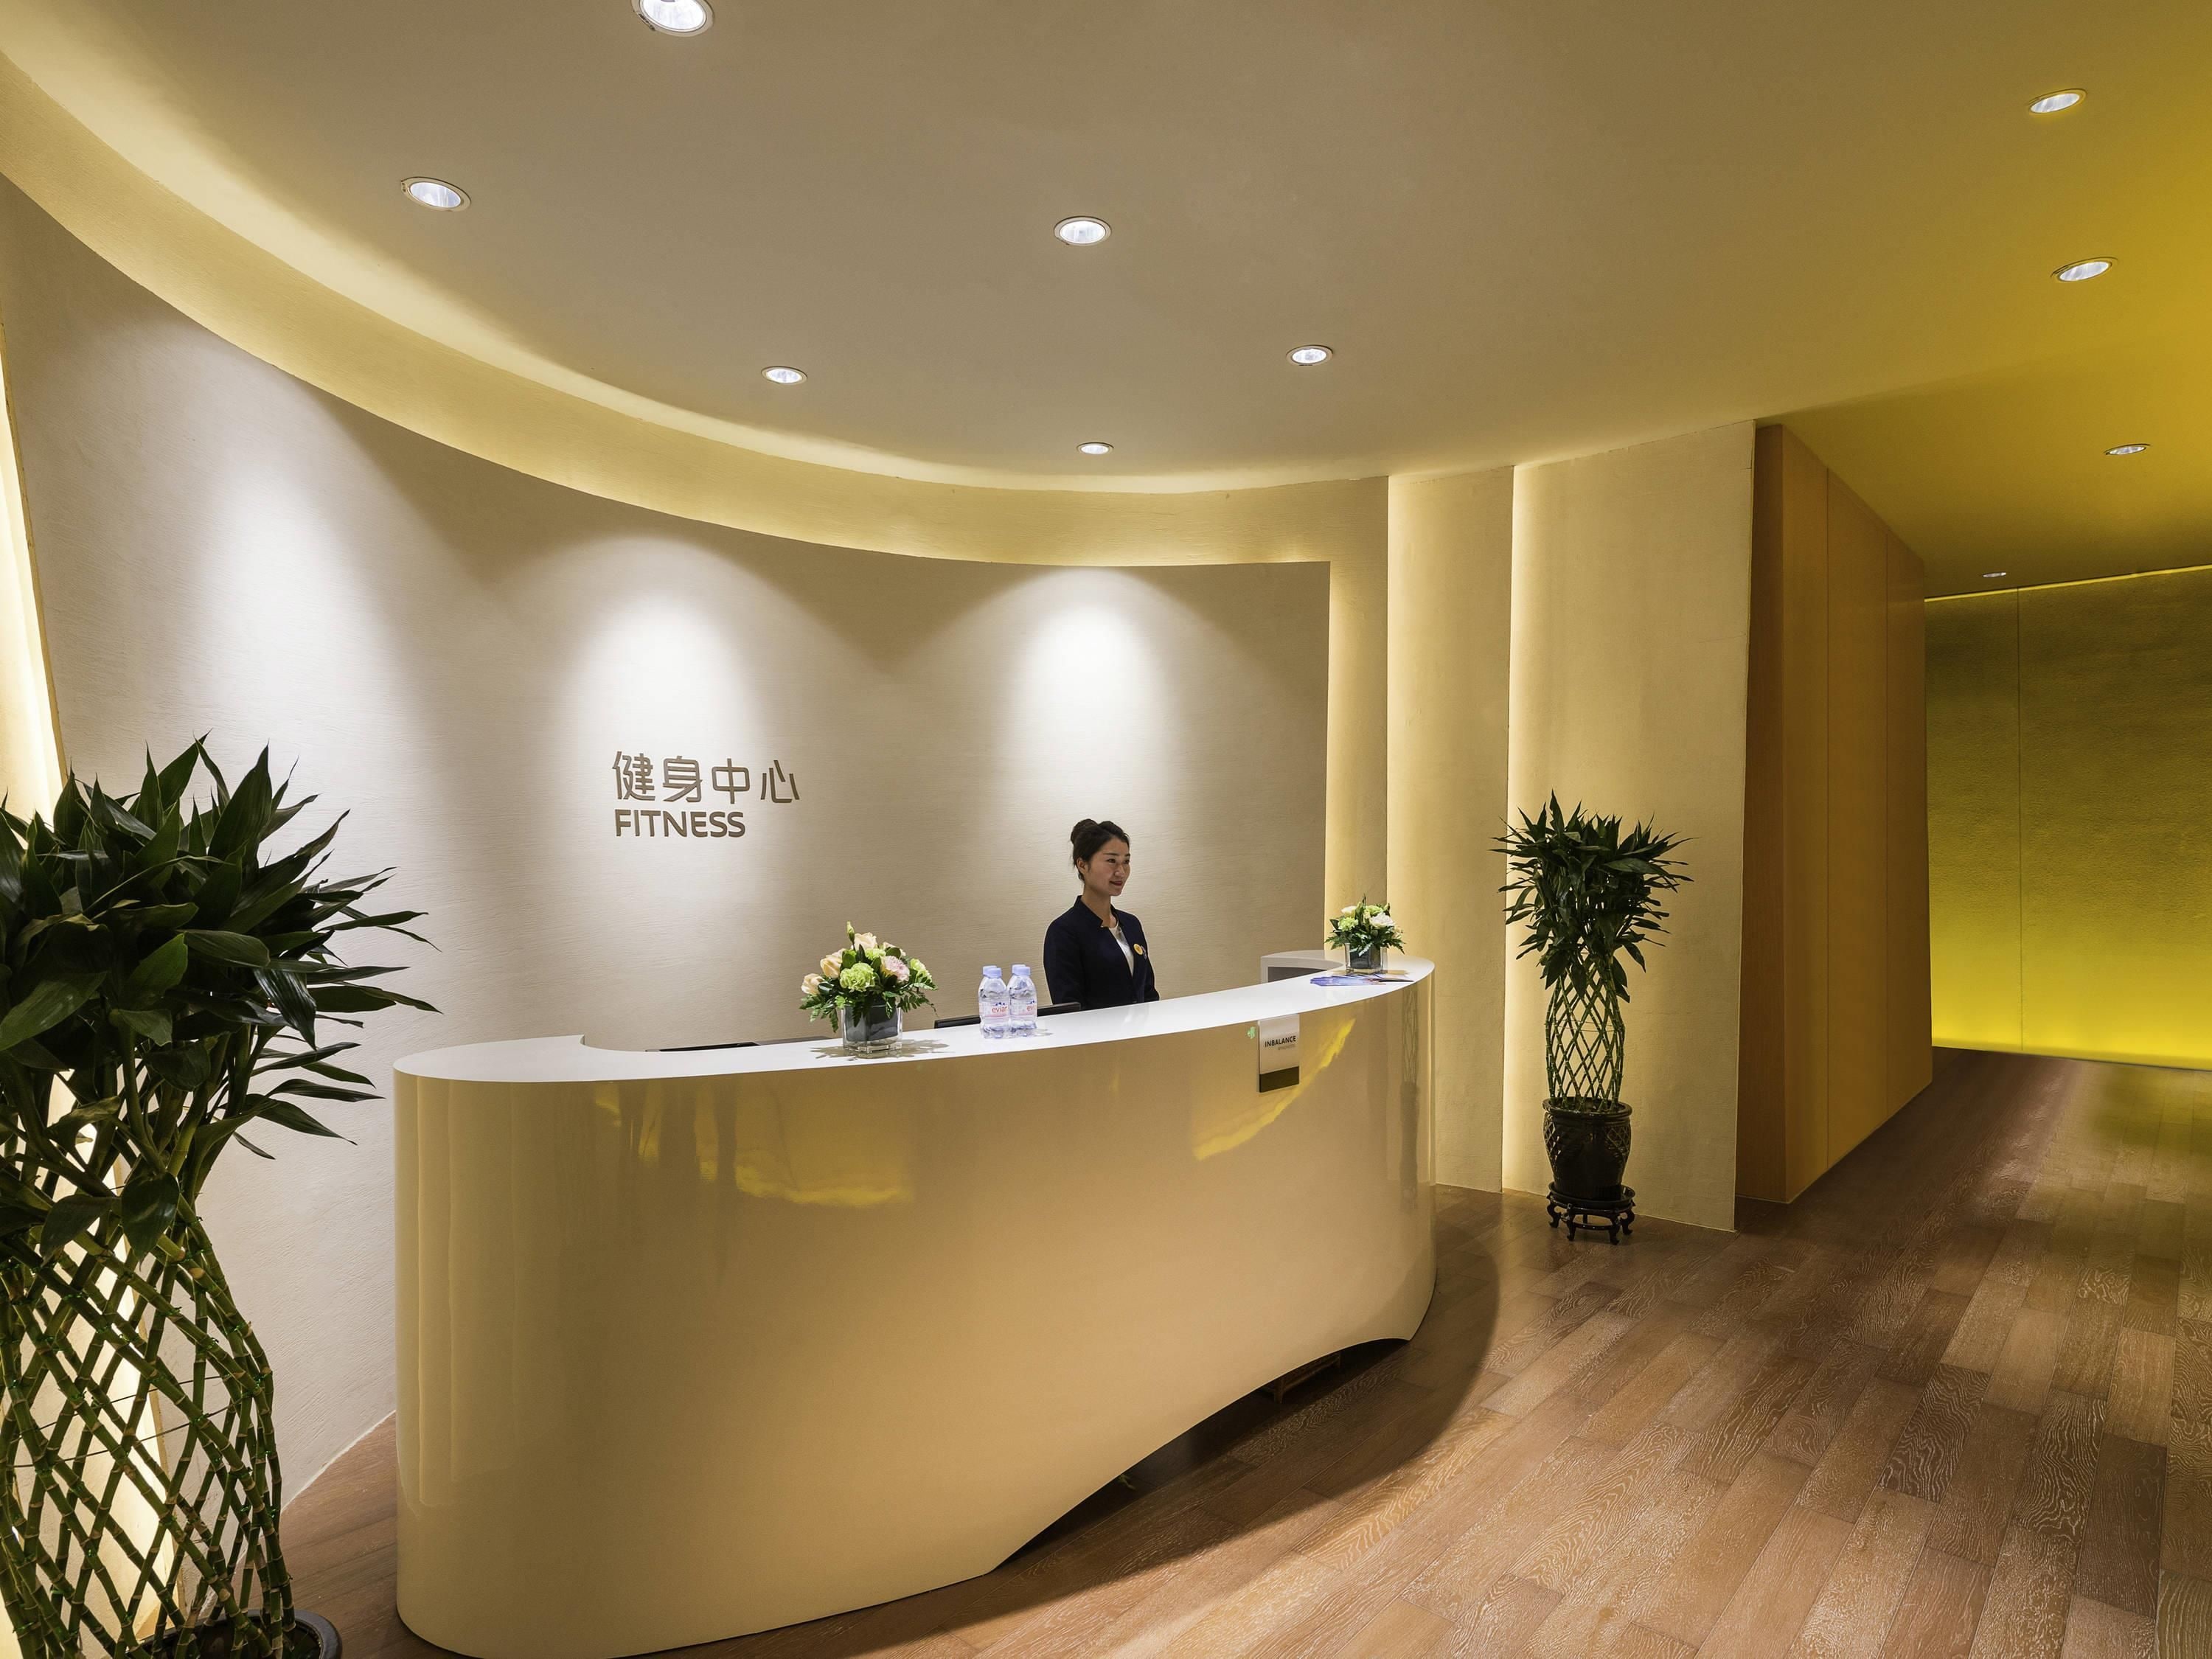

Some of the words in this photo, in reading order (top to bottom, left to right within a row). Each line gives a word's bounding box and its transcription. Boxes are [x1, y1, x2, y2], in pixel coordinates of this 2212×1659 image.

[612, 751, 800, 804] 健身中心
[614, 809, 746, 838] FITNESS
[1265, 1035, 1296, 1048] INBALANCE
